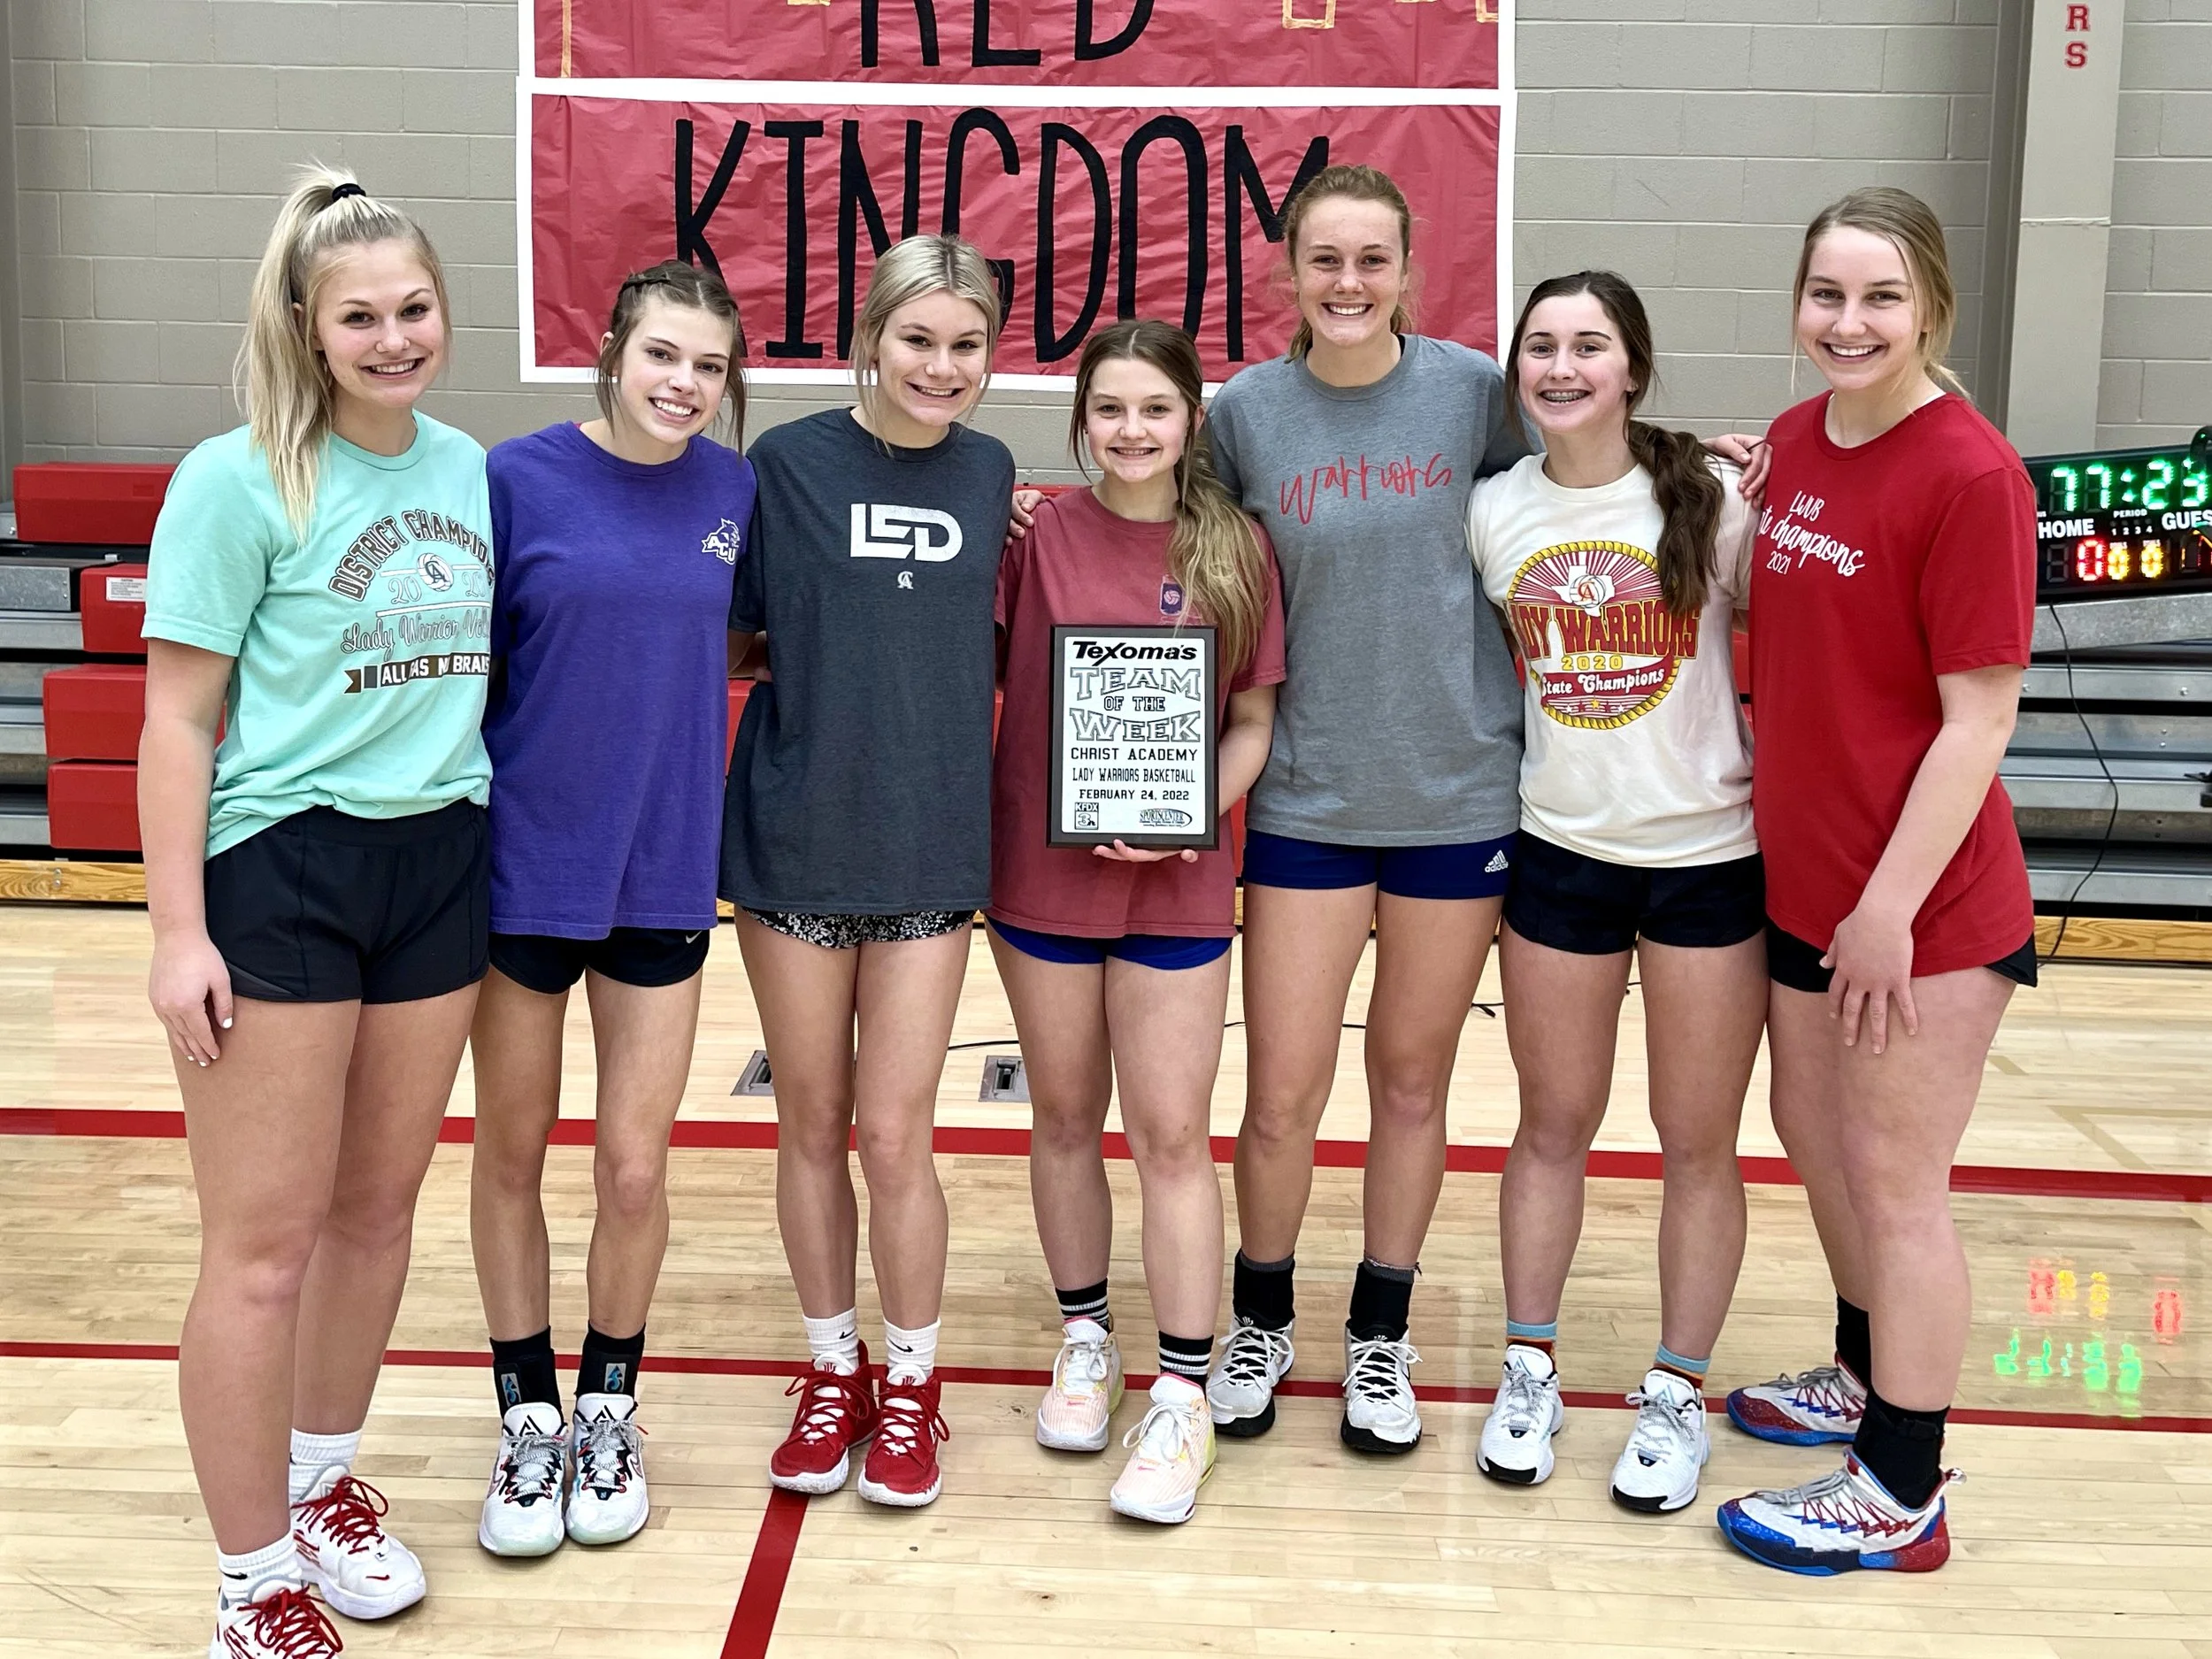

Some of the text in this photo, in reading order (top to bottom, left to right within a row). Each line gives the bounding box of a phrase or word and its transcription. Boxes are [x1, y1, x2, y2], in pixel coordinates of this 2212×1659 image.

[675, 106, 1330, 364] KINGDOM
[2113, 509, 2148, 518] PERIOD
[850, 503, 964, 563] LED
[2038, 518, 2096, 539] HOME
[2134, 526, 2141, 534] 3
[2146, 525, 2153, 534] 4
[328, 509, 495, 602] DISTRICT CHAMPIOS
[1770, 513, 1866, 577] champions
[1766, 550, 1793, 575] 2021
[388, 576, 422, 604] 20
[341, 618, 396, 662] Lady
[1561, 655, 1624, 671] 2020
[1070, 667, 1201, 702] TEAM
[1541, 667, 1665, 695] State Champions
[1104, 696, 1165, 711] OF THE
[1070, 708, 1201, 742] WEEK
[1071, 748, 1197, 761] CHRIST ACADEMY
[1072, 767, 1196, 783] LADY WARRIORS BASKETBALL
[1079, 789, 1189, 801] FEBRUARY 24, 2022
[1075, 803, 1099, 811] KFDX
[1077, 812, 1092, 826] 3
